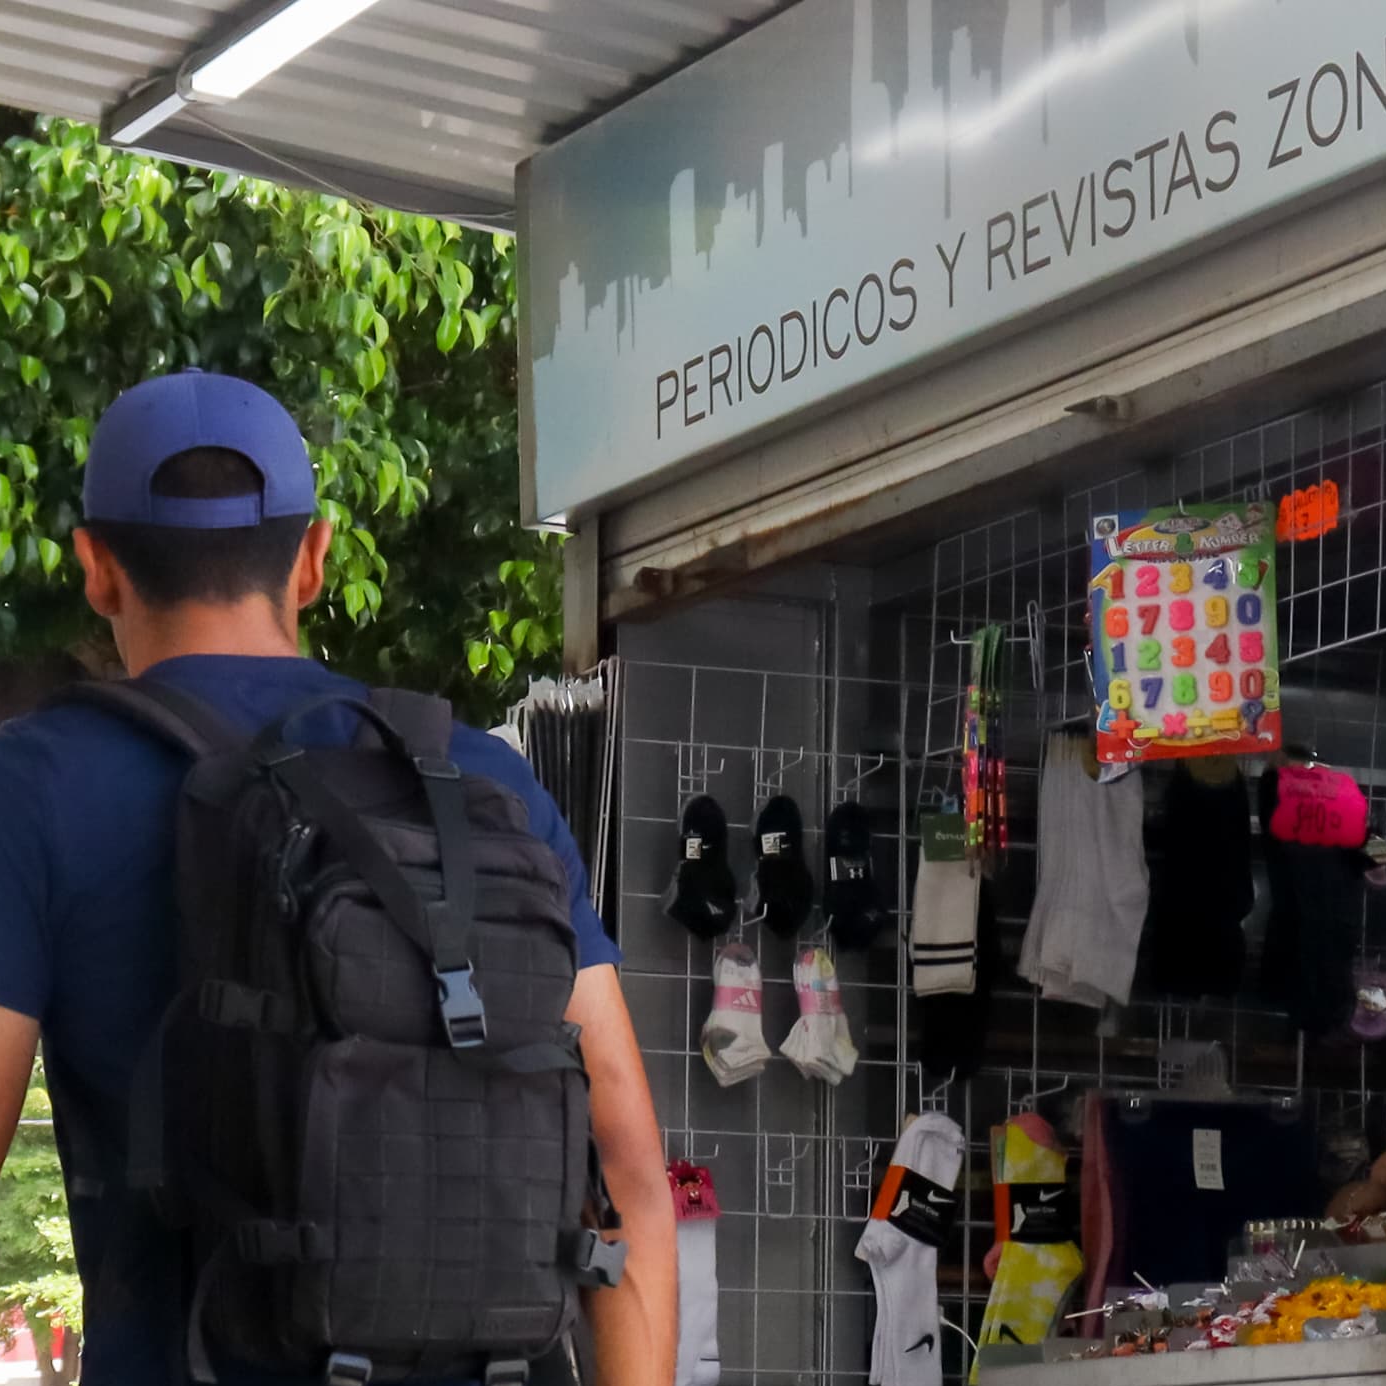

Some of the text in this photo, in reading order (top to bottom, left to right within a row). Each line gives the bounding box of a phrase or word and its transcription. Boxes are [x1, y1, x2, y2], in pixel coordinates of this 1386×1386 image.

[656, 257, 918, 441] PERIODICOS
[934, 231, 966, 309] Y
[986, 109, 1242, 291] REVISTAS
